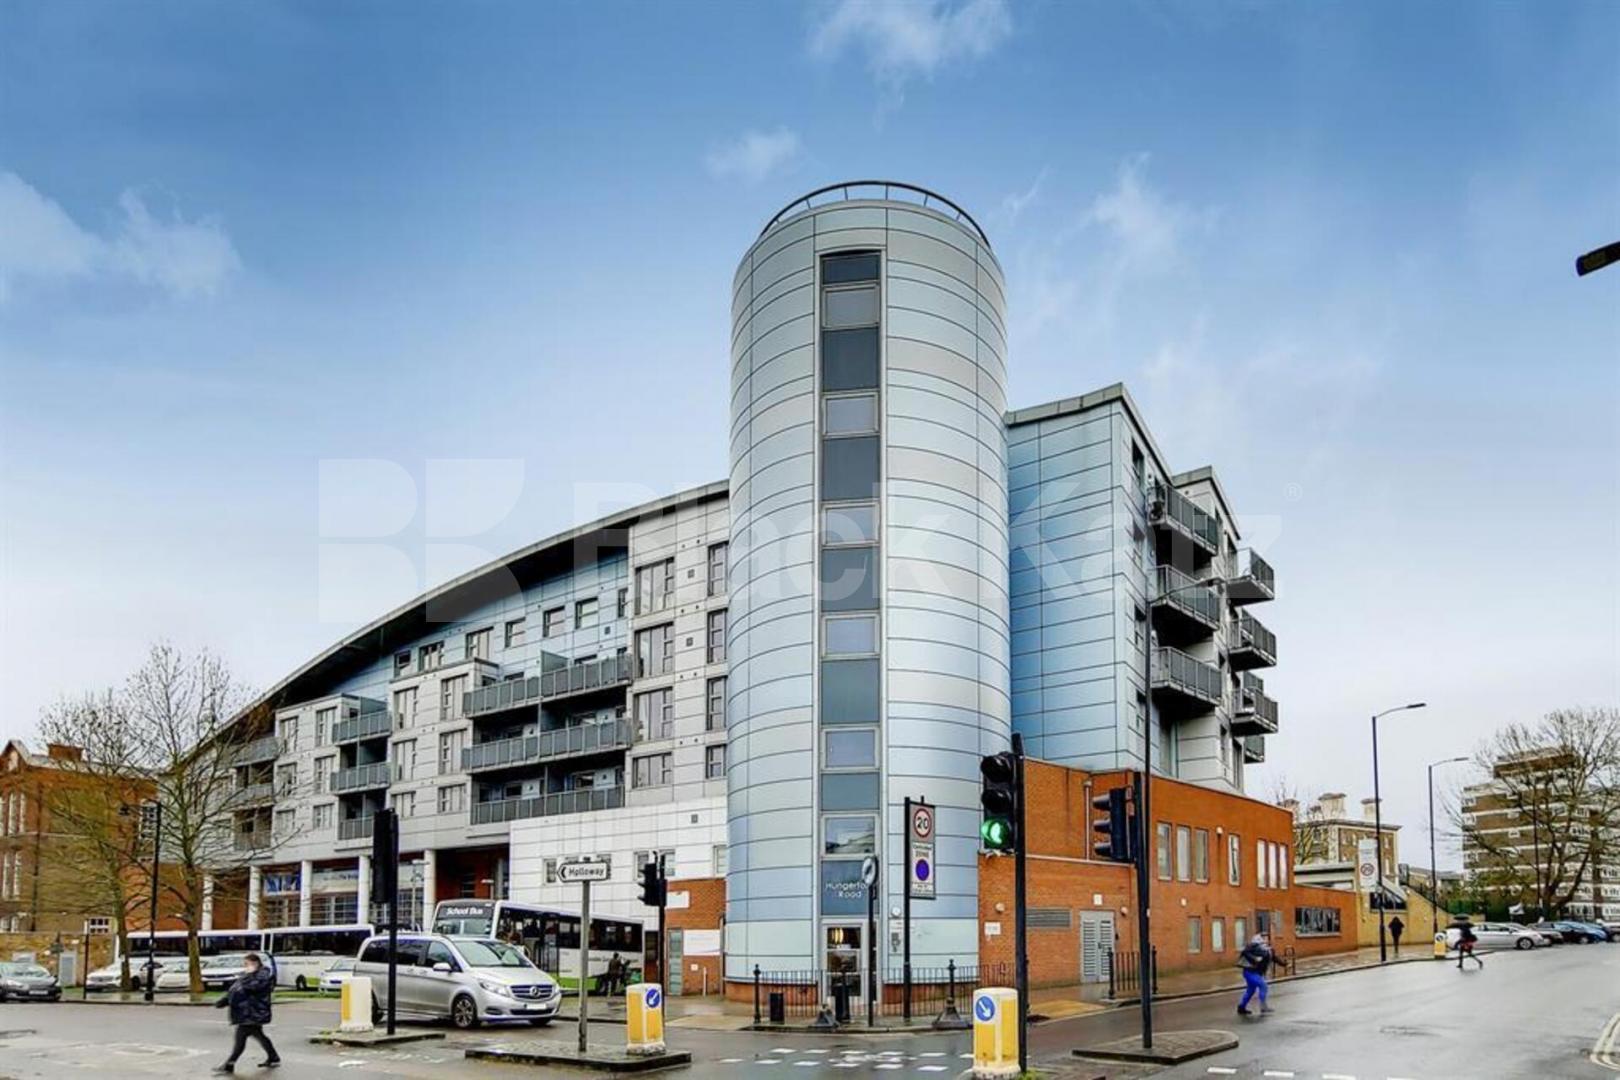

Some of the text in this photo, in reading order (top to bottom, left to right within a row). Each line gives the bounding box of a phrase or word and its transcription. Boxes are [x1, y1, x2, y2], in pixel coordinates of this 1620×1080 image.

[917, 816, 929, 830] 20
[568, 866, 604, 877] Holloway
[839, 889, 862, 898] Road
[446, 907, 484, 916] School Bus
